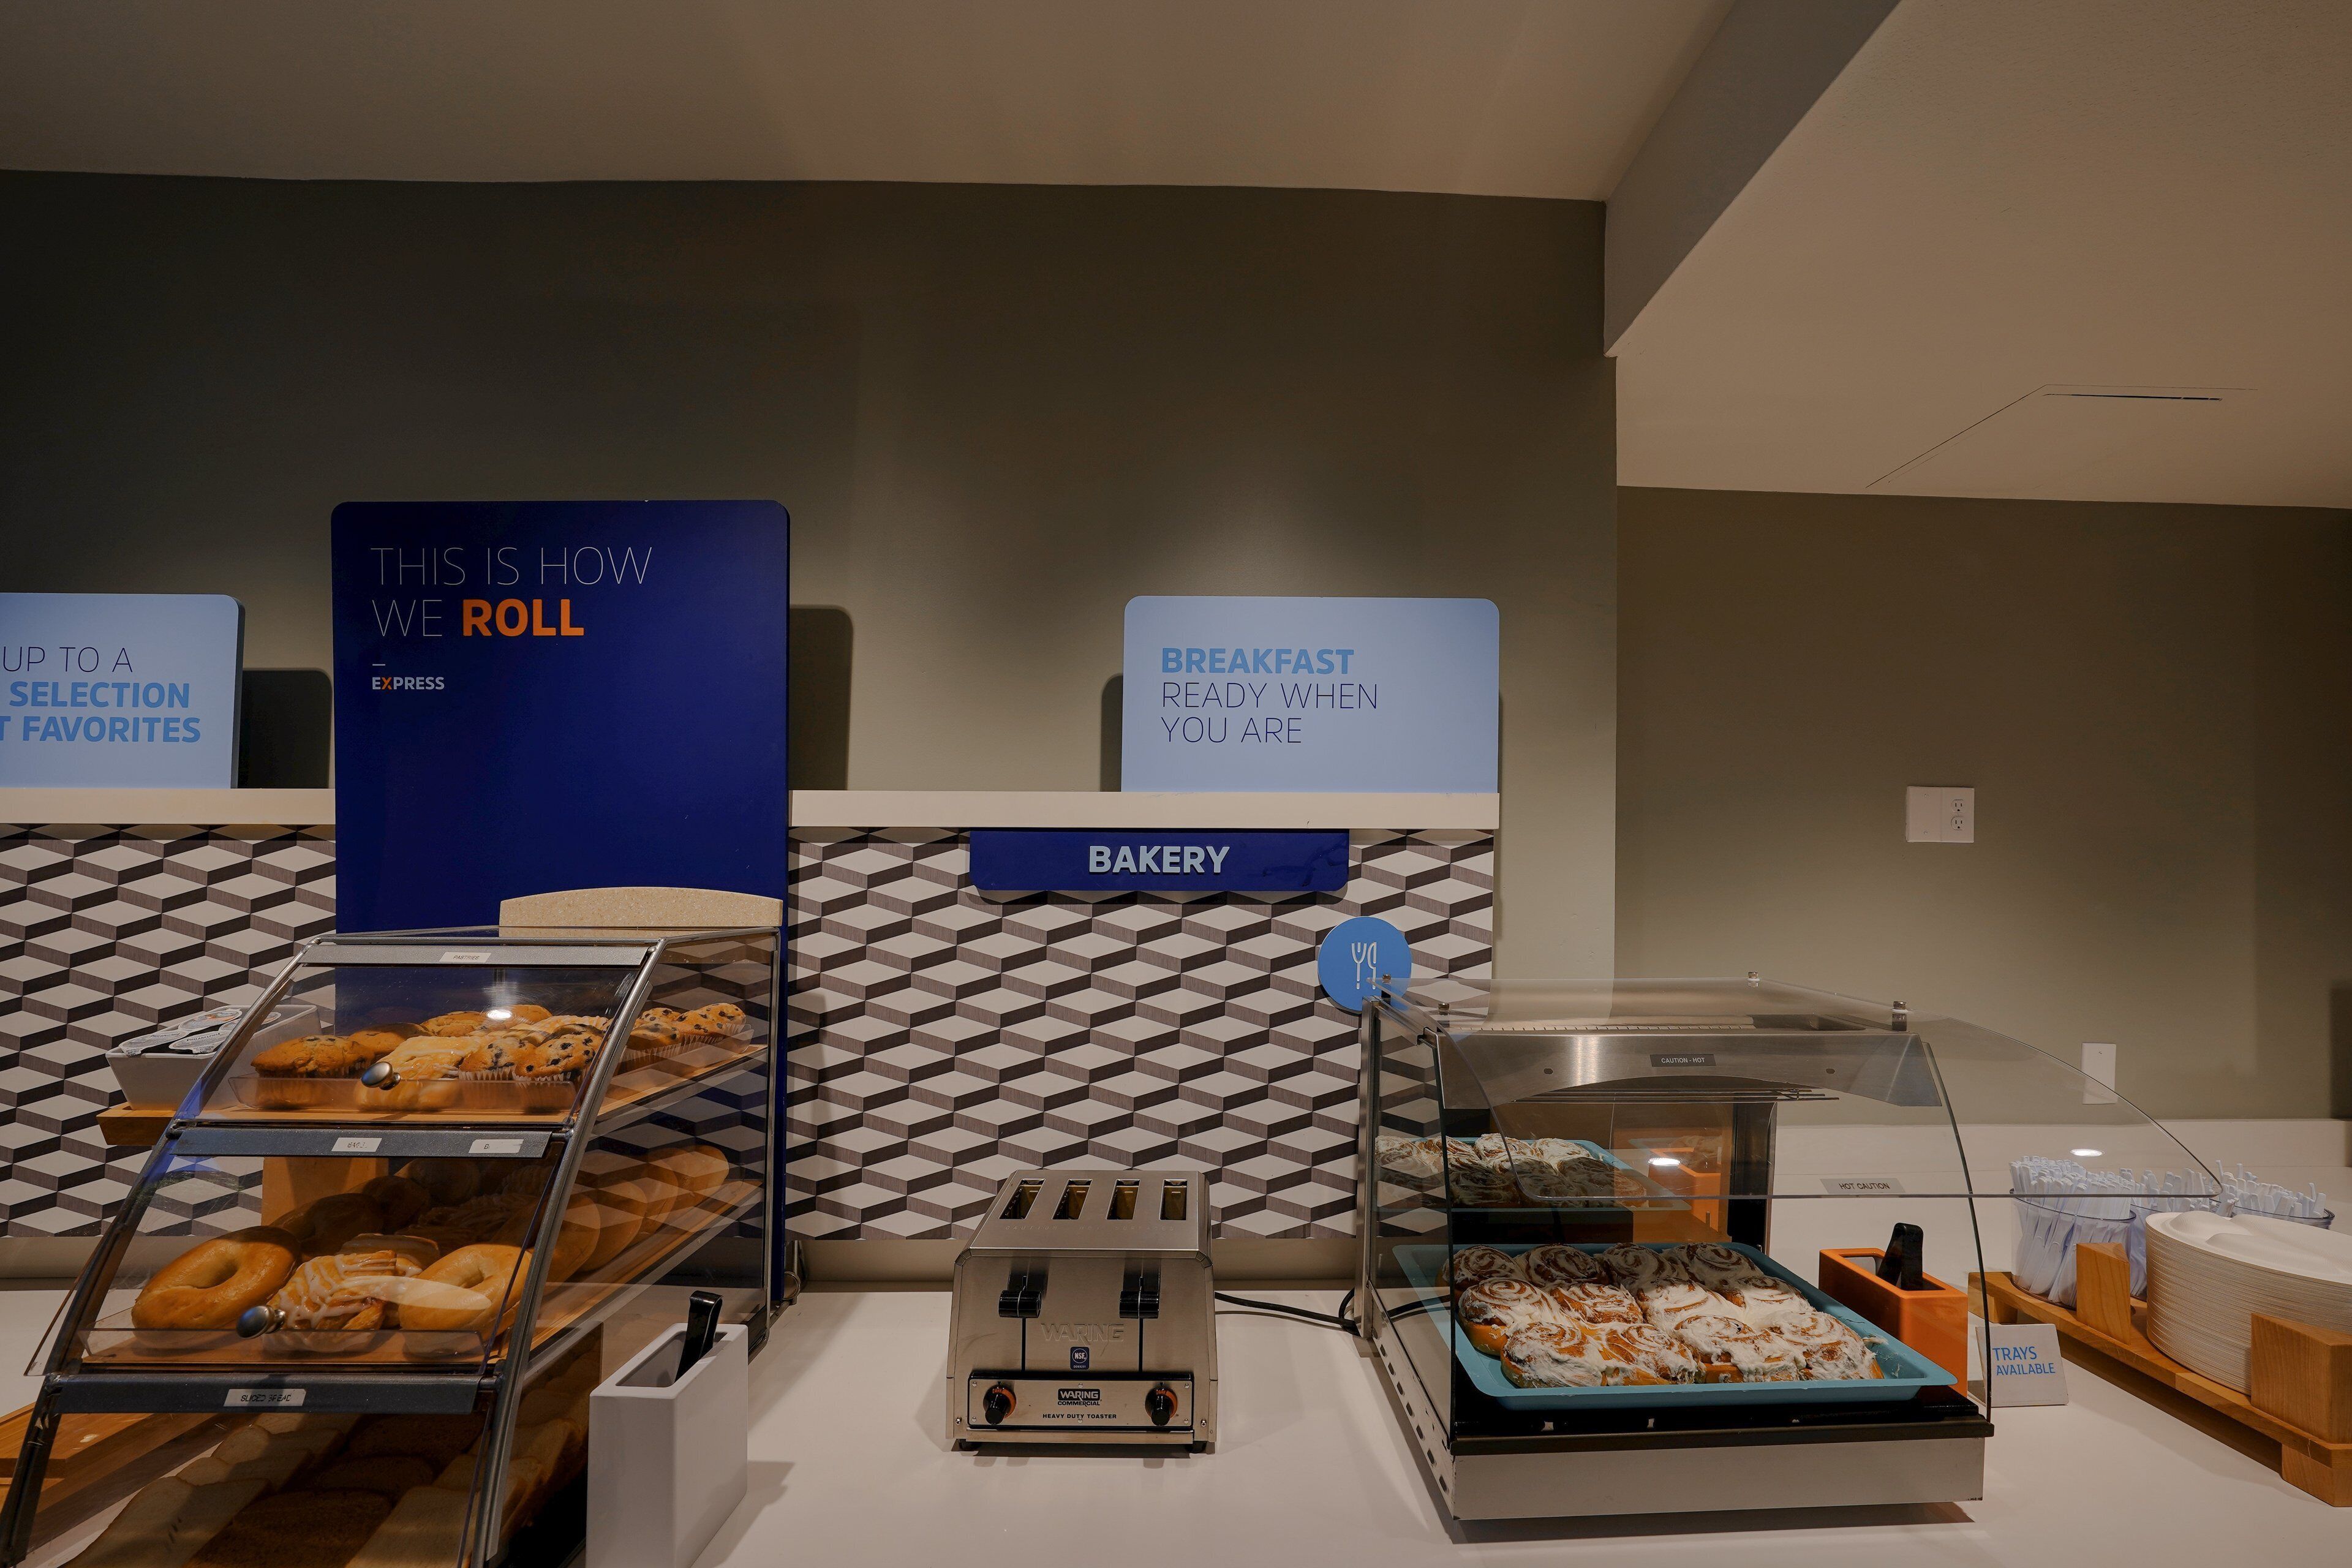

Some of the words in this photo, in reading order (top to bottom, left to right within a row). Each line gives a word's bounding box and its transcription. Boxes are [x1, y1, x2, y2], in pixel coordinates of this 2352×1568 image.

[370, 546, 466, 586] THIS
[488, 546, 519, 586] IS
[541, 546, 652, 585] HOW
[372, 599, 443, 637] WE
[462, 598, 585, 637] ROLL
[2, 646, 46, 673] UP
[59, 646, 99, 673] TO
[111, 647, 133, 673] A
[1161, 647, 1355, 674] BREAKFAST
[9, 680, 190, 709] SELECTION
[372, 676, 445, 691] EXPRESS
[1163, 682, 1268, 709] READY
[1280, 682, 1377, 709] WHEN
[22, 715, 201, 743] FAVORITES
[1161, 716, 1227, 744] YOU
[1240, 717, 1302, 744] ARE
[1088, 845, 1231, 873] BAKERY
[1041, 1323, 1125, 1347] WARING
[1992, 1346, 2037, 1361] TRAYS
[1997, 1363, 2056, 1376] AVAILABLE
[1060, 1390, 1099, 1401] WARING
